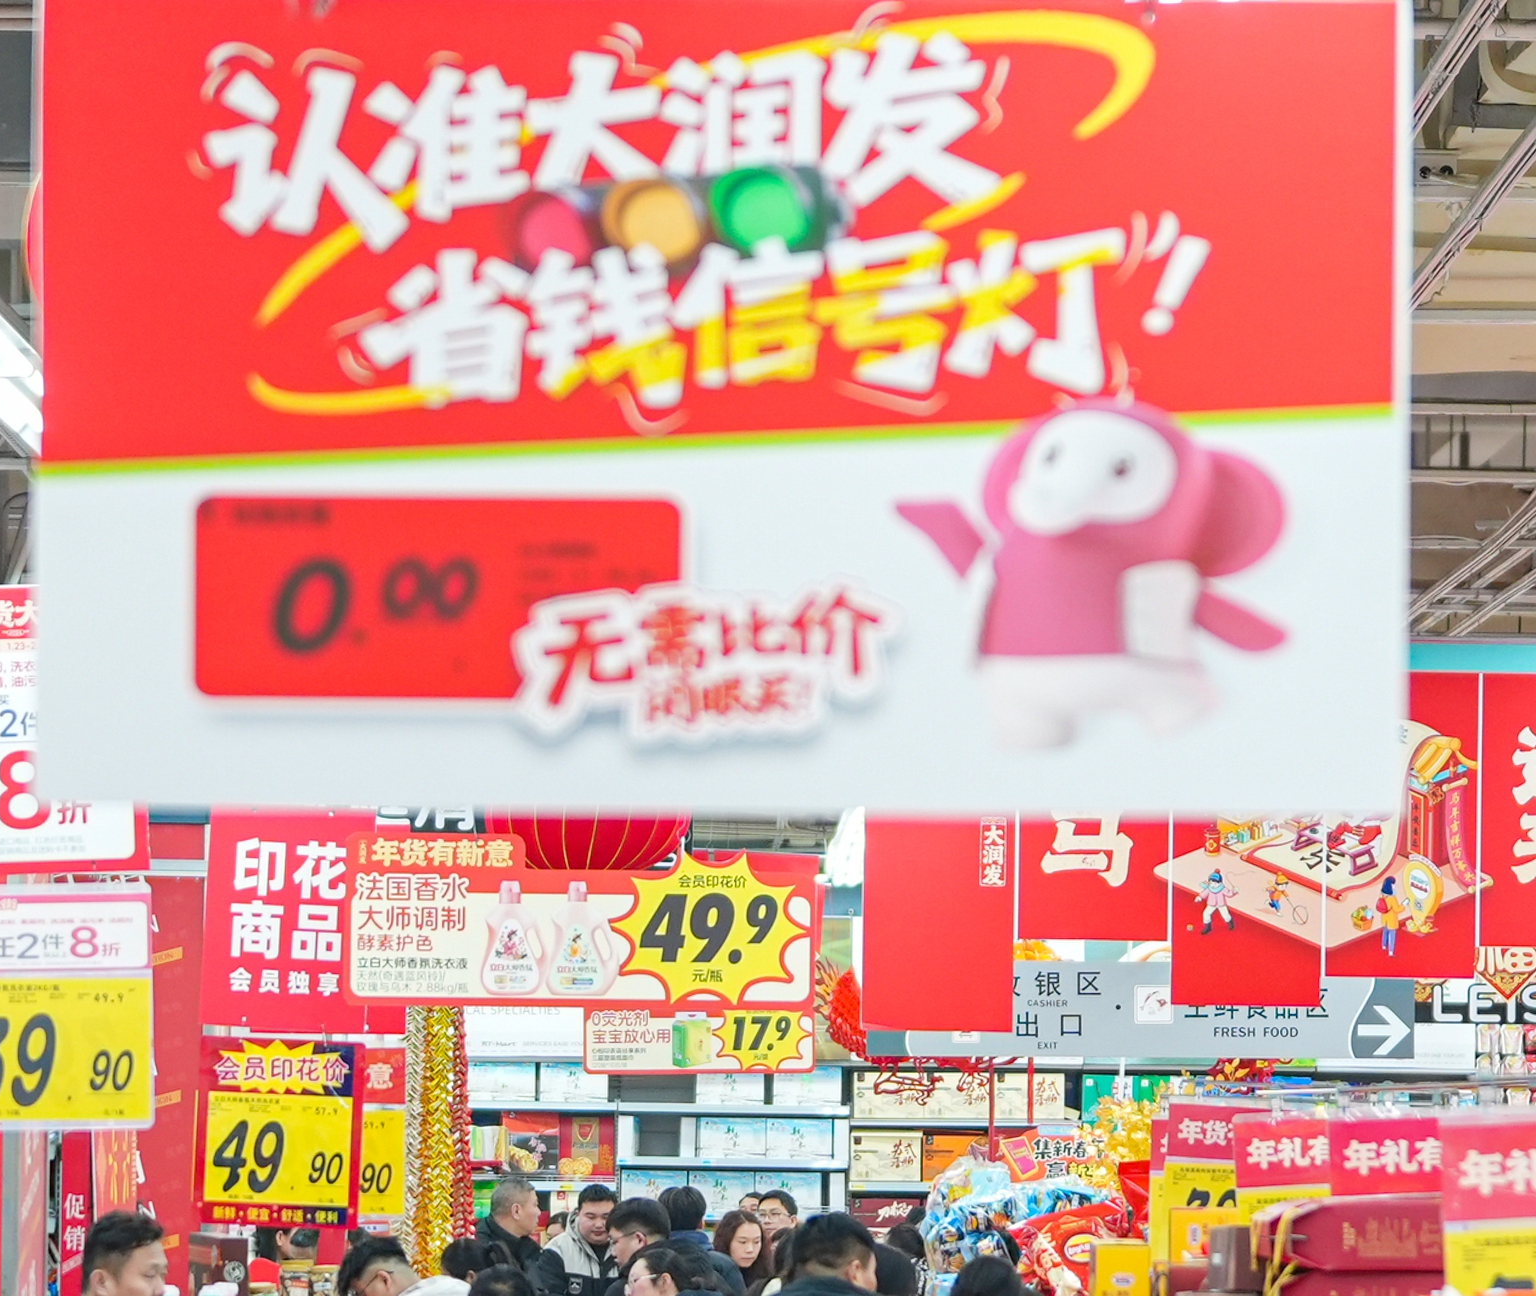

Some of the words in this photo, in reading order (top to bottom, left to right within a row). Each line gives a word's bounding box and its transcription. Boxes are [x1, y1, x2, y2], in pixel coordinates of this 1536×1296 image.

[204, 33, 1003, 252] 认准大润发
[542, 590, 884, 707] 无需比价
[371, 837, 514, 868] 年货有新意
[982, 825, 1006, 887] 大润发
[233, 836, 348, 900] 印花
[678, 874, 748, 890] 会员印花价
[355, 872, 469, 902] 法国香水
[229, 900, 343, 962] 商品
[357, 905, 467, 933] 大师调制
[639, 891, 779, 966] 49.9
[356, 934, 434, 952] 酵素护色
[356, 956, 469, 970] 立白大师香氛洗衣液
[691, 968, 724, 984] 元/瓶
[228, 966, 340, 996] 会员独享
[1027, 999, 1068, 1008] CASHIER
[591, 1010, 650, 1028] 0荧光剂
[732, 1015, 793, 1052] 17.9
[1015, 1012, 1084, 1038] 出口
[1213, 1026, 1256, 1038] FRESH
[1263, 1026, 1300, 1038] FOOD
[591, 1028, 672, 1045] 宝宝放心用
[1037, 1041, 1059, 1050] EXIT
[89, 1049, 134, 1093] 90
[214, 1054, 350, 1085] 会员印花价
[365, 1061, 395, 1091] 意
[1178, 1118, 1234, 1147] 年货
[212, 1118, 285, 1194] 49
[308, 1151, 344, 1186] 90
[361, 1162, 393, 1195] 90
[63, 1192, 87, 1253] 促销
